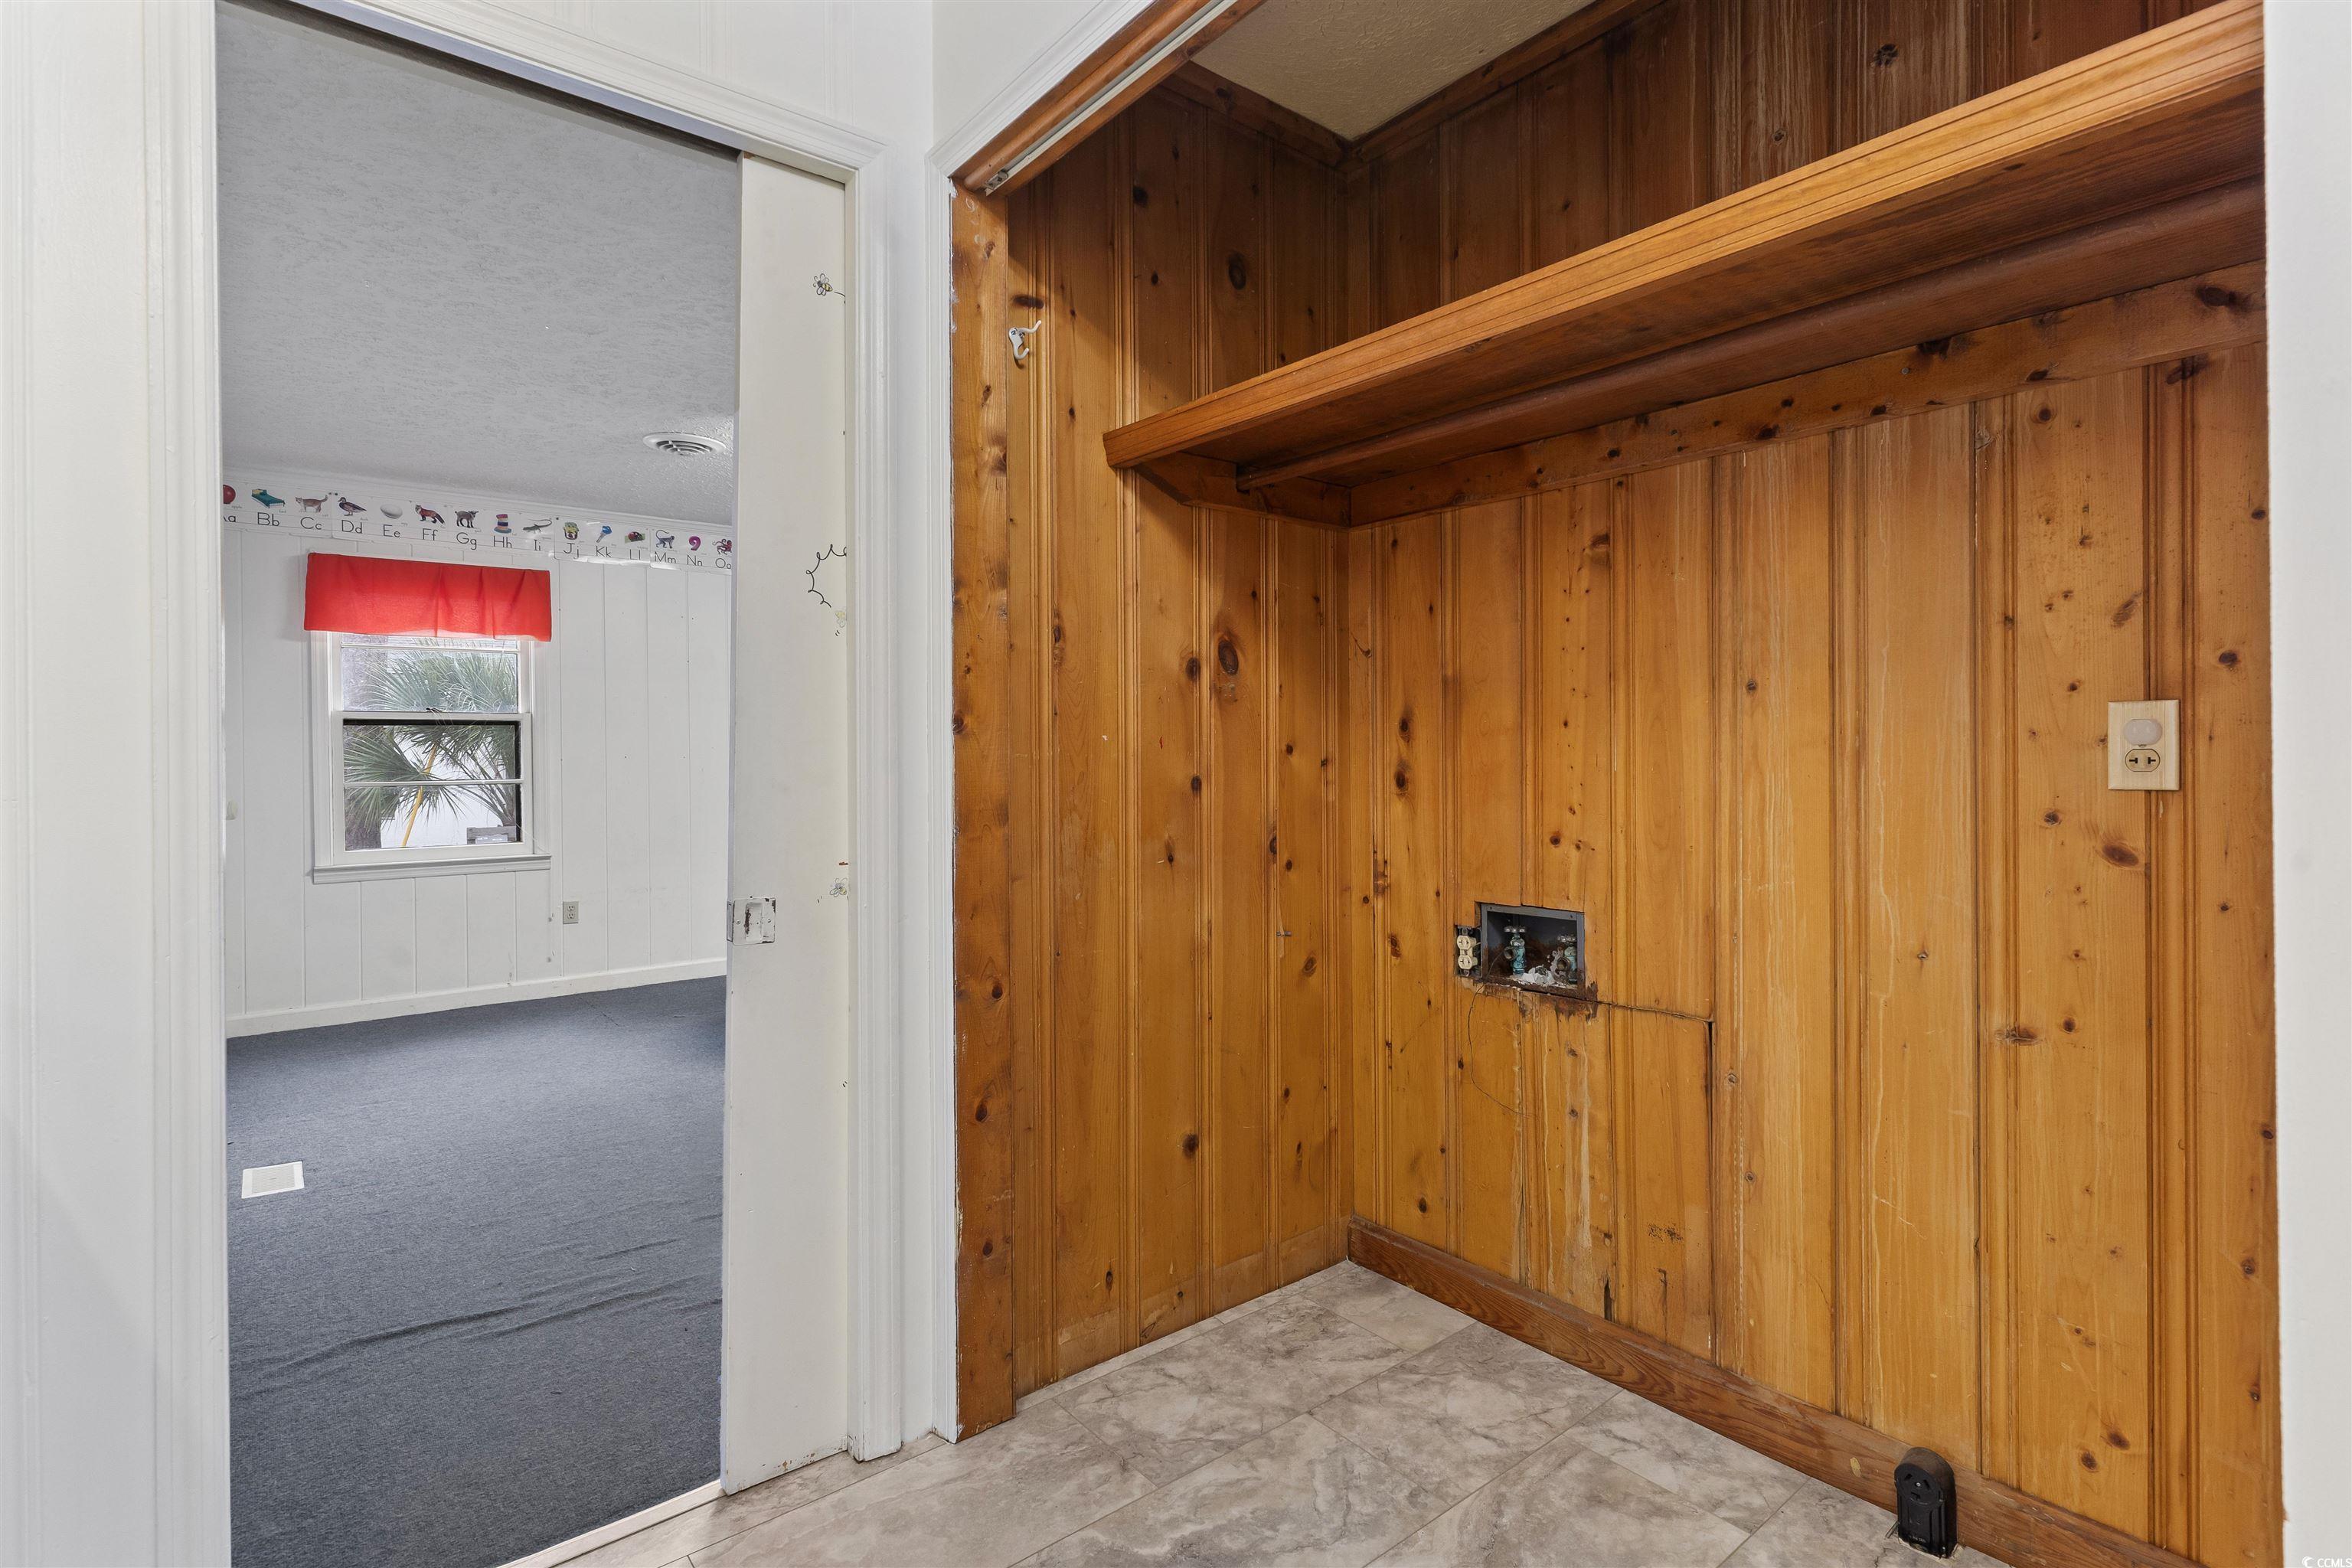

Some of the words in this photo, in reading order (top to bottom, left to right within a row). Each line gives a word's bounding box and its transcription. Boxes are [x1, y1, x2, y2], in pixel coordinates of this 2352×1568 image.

[257, 511, 279, 526] Bb
[300, 517, 322, 530] Cc
[341, 519, 362, 534] Dd
[383, 524, 400, 537] Ee
[423, 528, 438, 541] Ff
[456, 532, 477, 550] Gg
[493, 535, 512, 548] Hh
[534, 539, 541, 551] Ii
[564, 542, 579, 559] Jj
[596, 546, 612, 557] Kk
[629, 549, 640, 560] Ll
[654, 551, 676, 564] Mm
[687, 554, 703, 567] Nn
[715, 558, 732, 569] Oo
